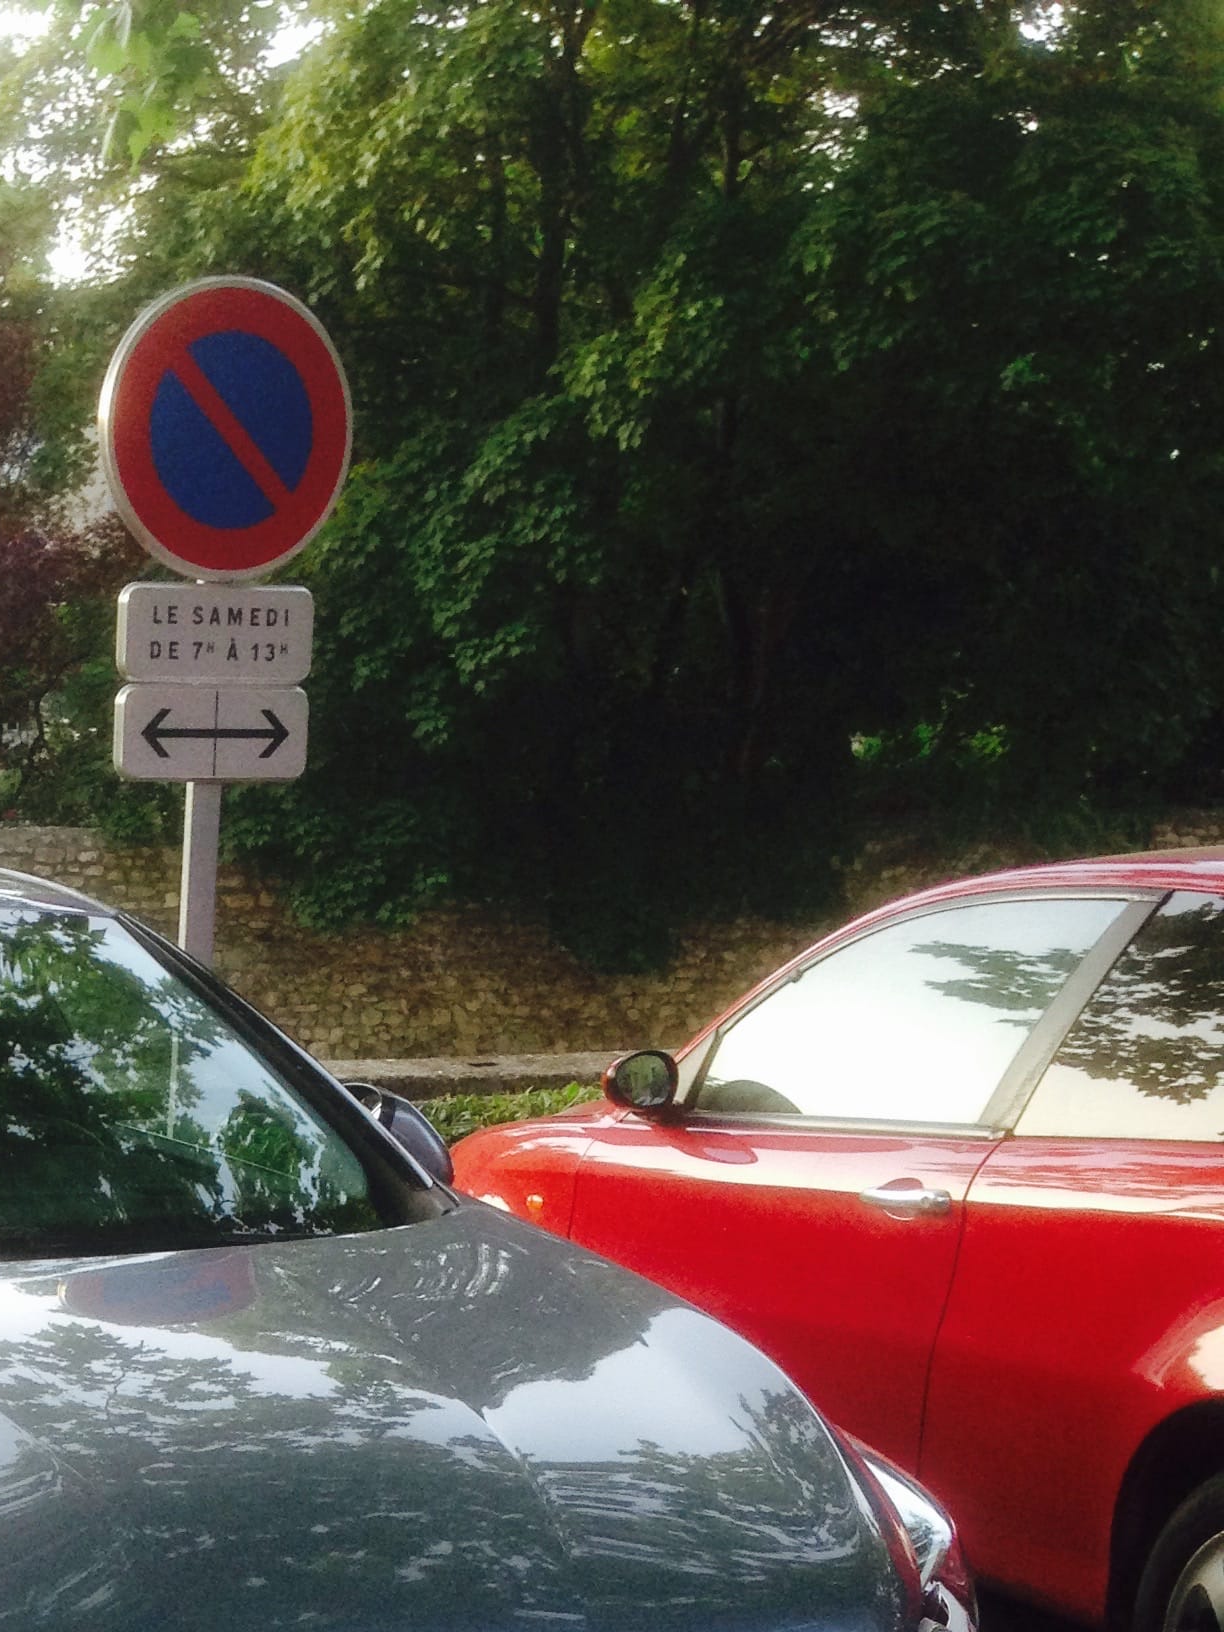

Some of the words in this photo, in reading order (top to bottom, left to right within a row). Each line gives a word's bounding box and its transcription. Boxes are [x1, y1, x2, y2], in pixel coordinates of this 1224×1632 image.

[153, 606, 178, 625] LE
[192, 606, 289, 627] SAMEDI
[150, 641, 179, 660] DE
[226, 638, 238, 661] À
